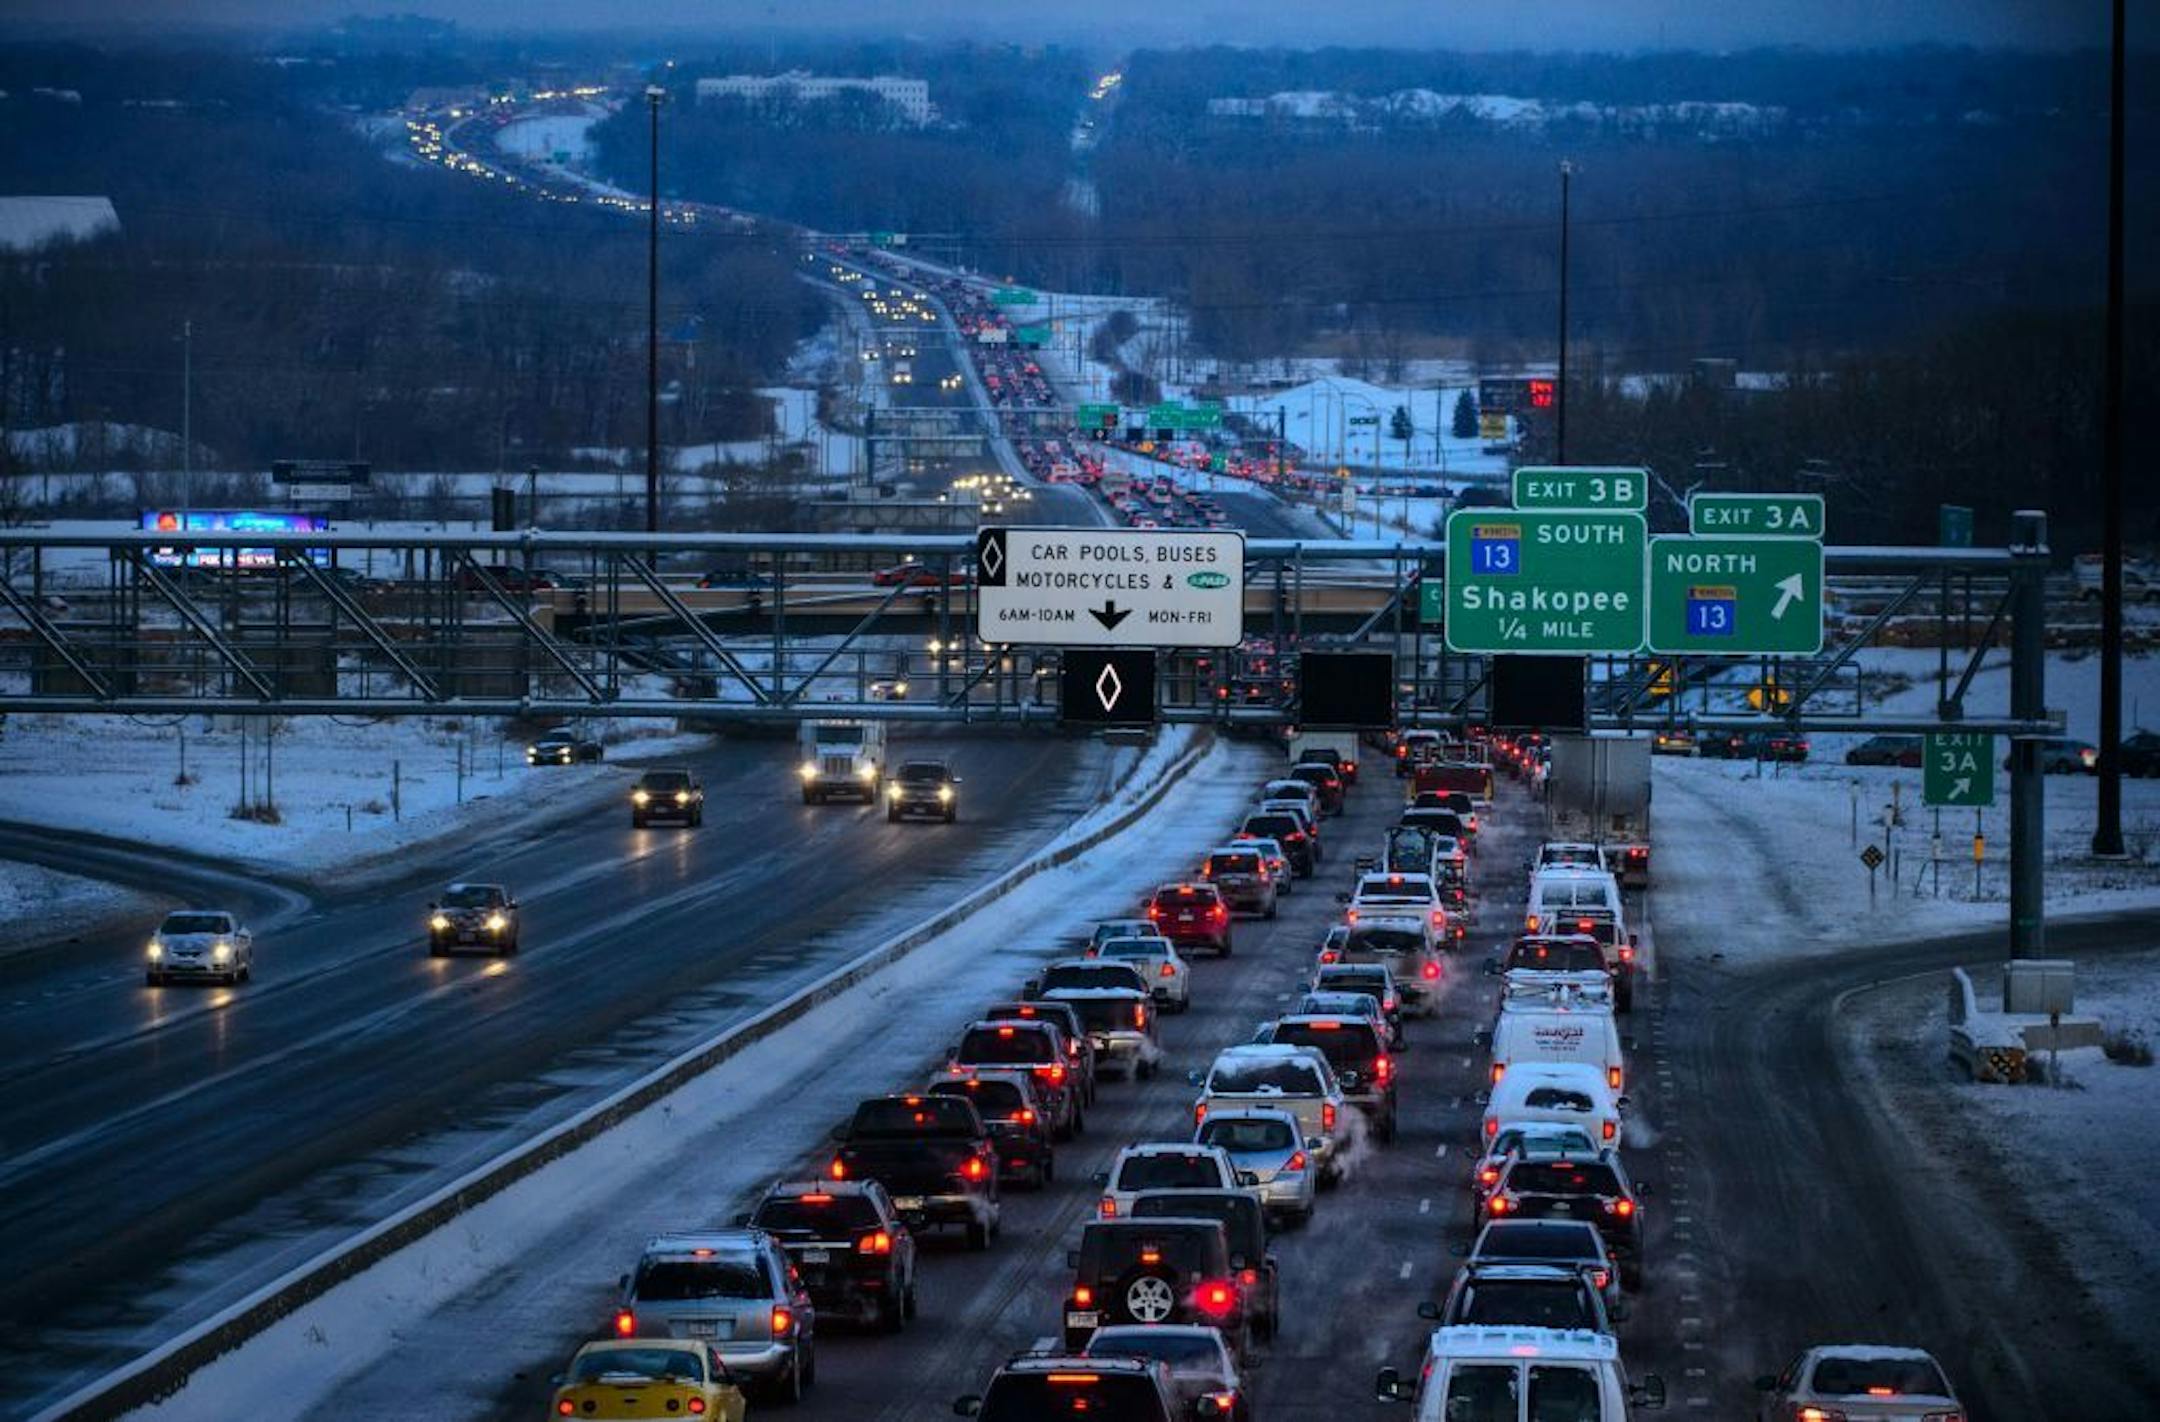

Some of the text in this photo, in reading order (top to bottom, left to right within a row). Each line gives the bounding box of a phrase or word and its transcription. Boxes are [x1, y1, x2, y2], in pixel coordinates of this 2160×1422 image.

[1527, 478, 1633, 501] EXIT 3B
[1703, 505, 1810, 529] EXIT 3A
[1537, 524, 1624, 544] SOUTH
[1031, 544, 1217, 563] CAR POOLS, BUSES
[1484, 545, 1510, 568] 13
[1667, 554, 1757, 574] NORTH
[1016, 572, 1150, 589] MOTORCYCLES
[1163, 574, 1173, 589] &
[1462, 585, 1630, 616] Shakopee
[999, 608, 1075, 621] 6AM-10AM
[1148, 610, 1212, 623] MON-FRI
[1699, 605, 1727, 628] 13
[1543, 622, 1594, 638] MILE
[1940, 752, 1978, 772] 3A
